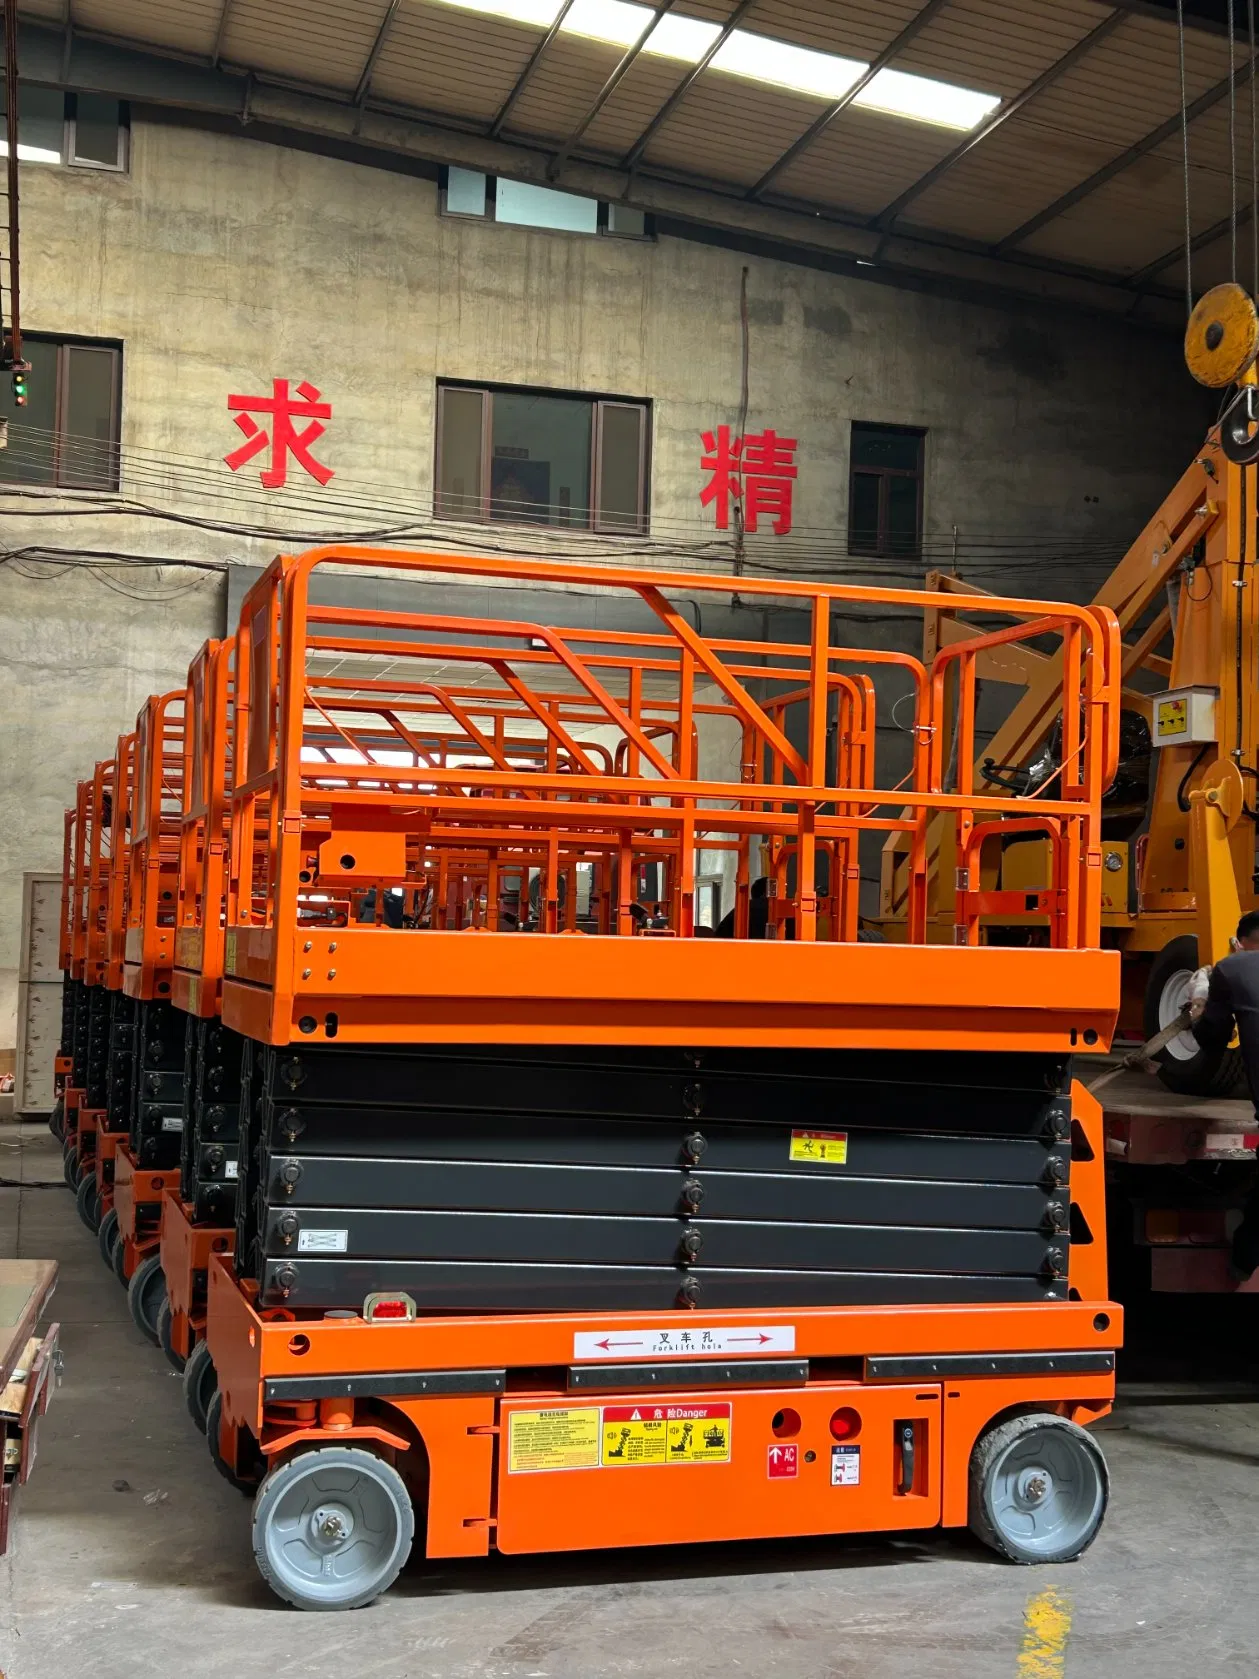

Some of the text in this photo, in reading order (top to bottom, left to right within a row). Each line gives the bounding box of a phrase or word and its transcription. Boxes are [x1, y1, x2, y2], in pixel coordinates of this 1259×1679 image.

[223, 378, 798, 535] 求 精
[660, 1331, 713, 1344] 叉车孔
[676, 1408, 708, 1419] Danger
[784, 1447, 795, 1462] AC
